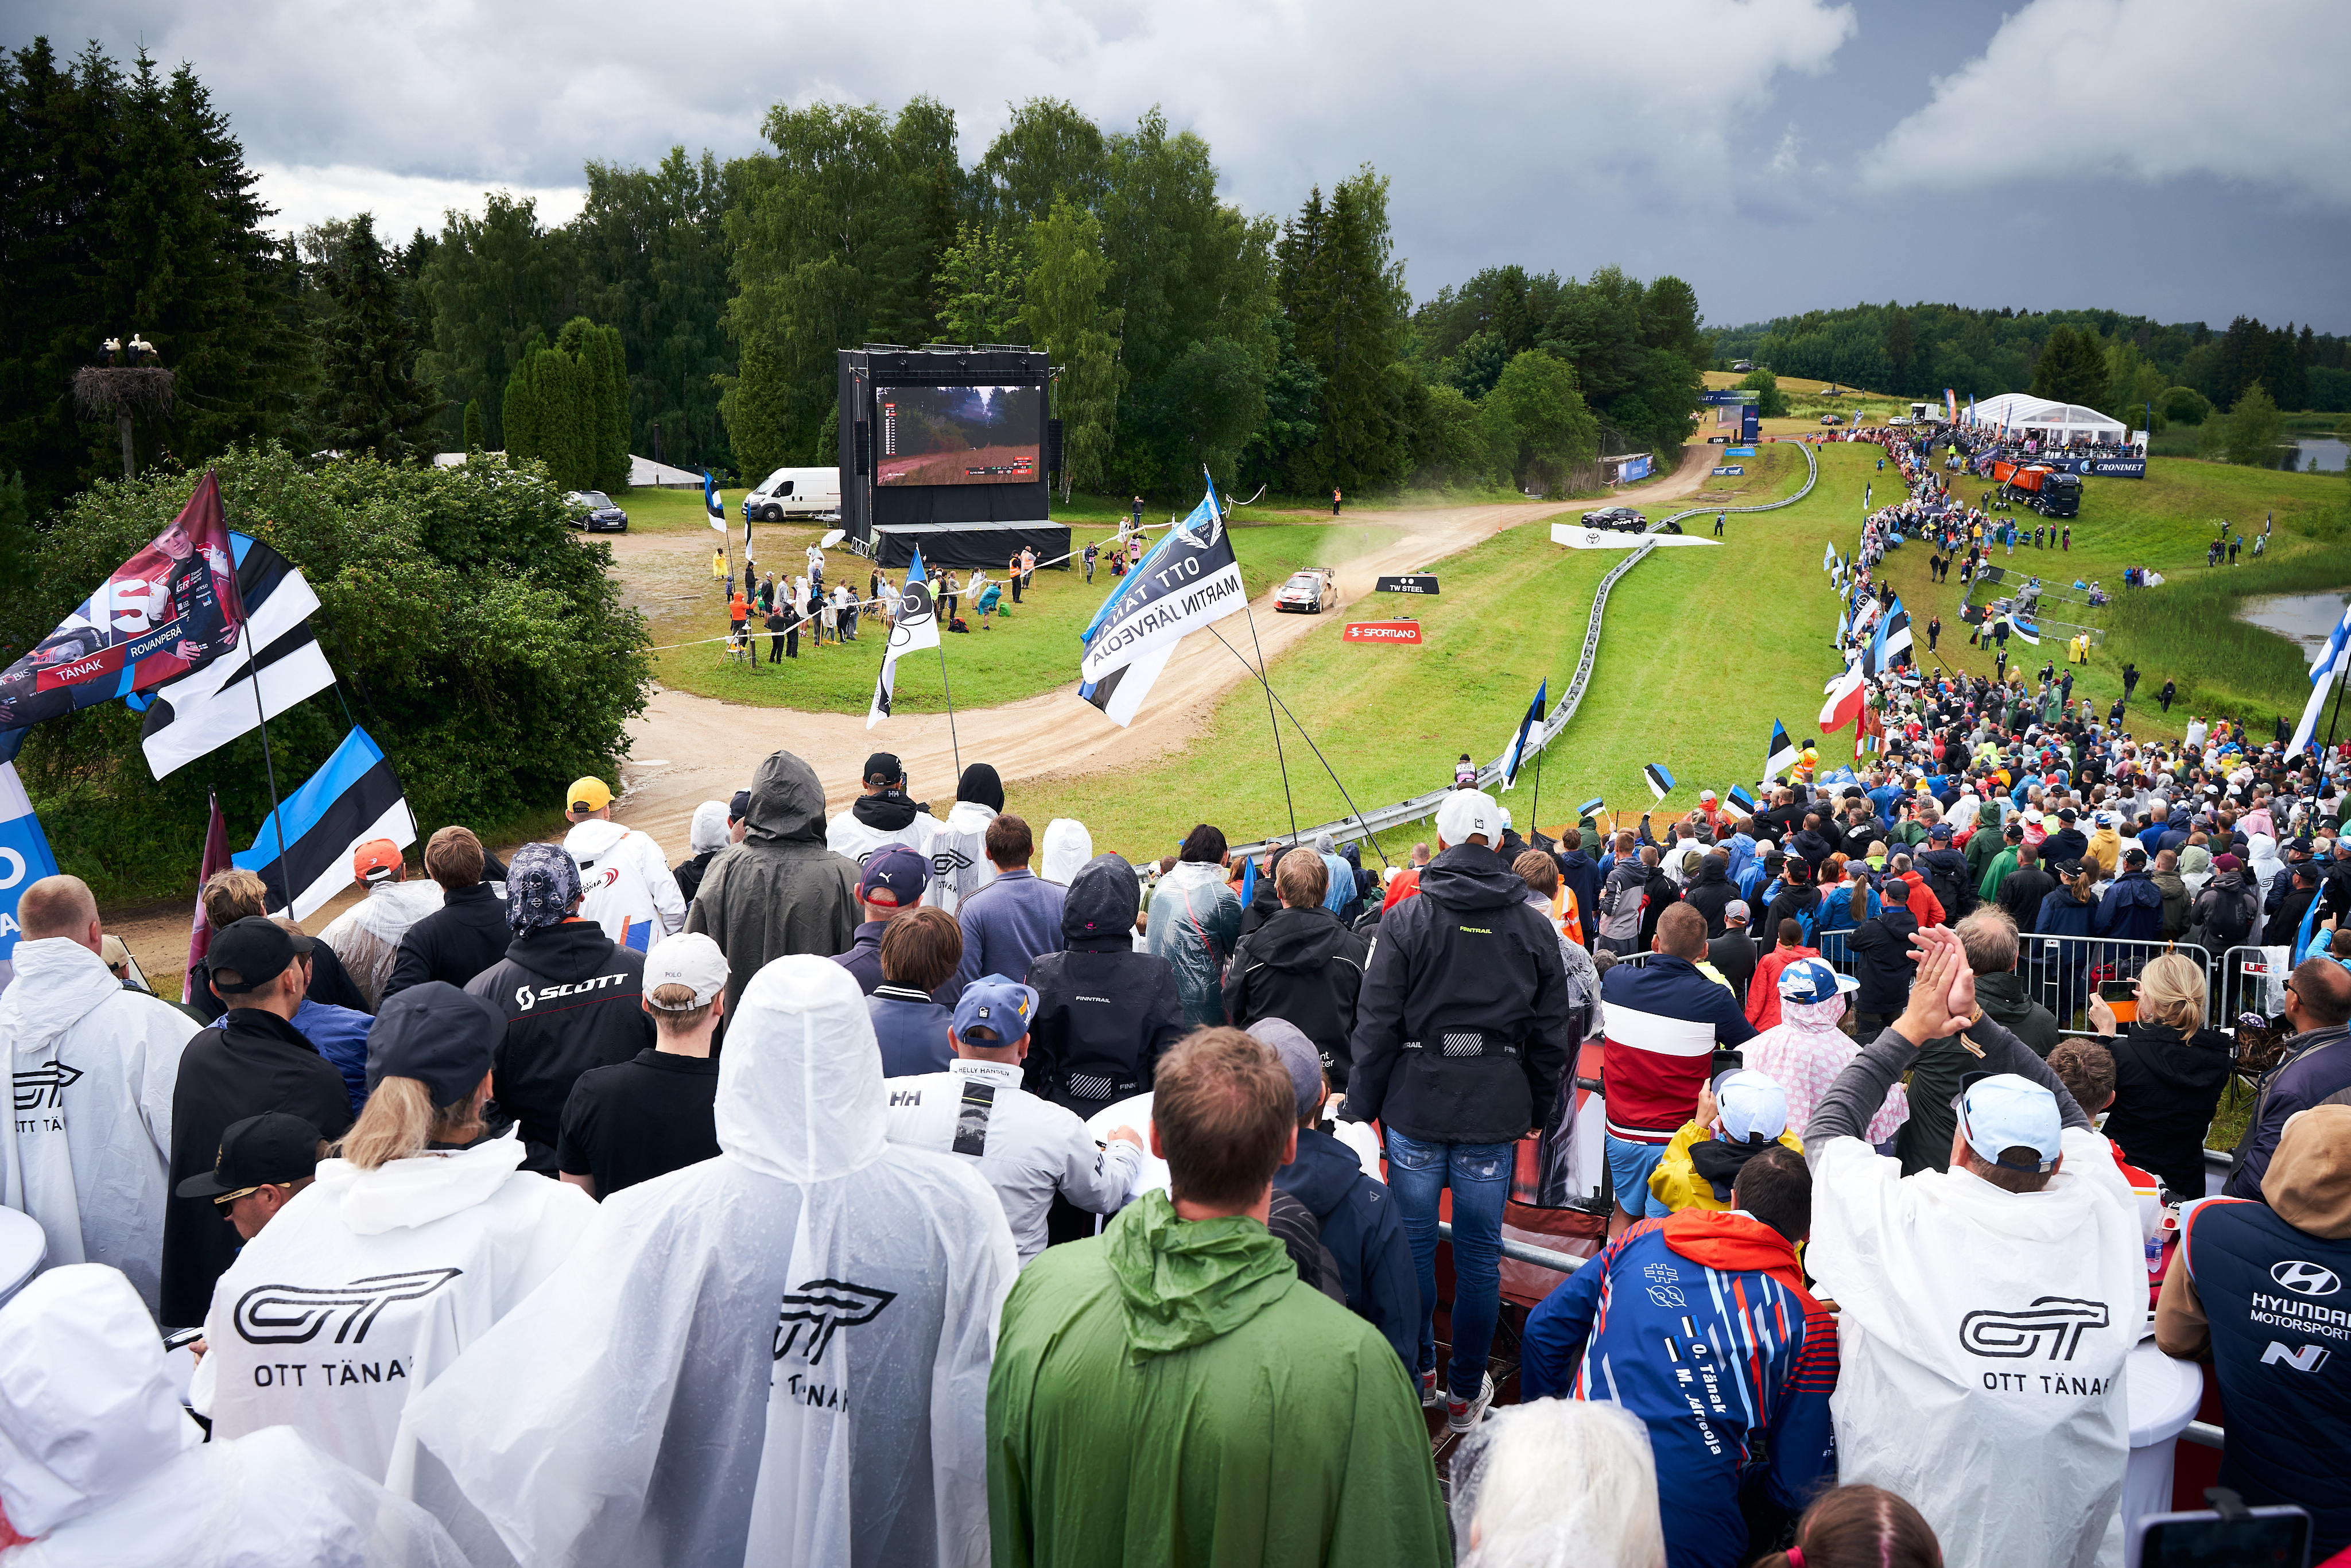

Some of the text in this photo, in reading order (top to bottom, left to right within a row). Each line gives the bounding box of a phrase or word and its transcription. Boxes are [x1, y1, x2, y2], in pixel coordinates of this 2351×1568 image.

[1979, 449, 1999, 460] CRONIMET
[1402, 585, 1424, 593] STEEL
[130, 623, 183, 658] ROVANPERÄ
[1364, 628, 1416, 638] SPORTLAND
[56, 658, 104, 681] TÄNAK
[1460, 926, 1492, 934] FINNTRAIL
[537, 973, 629, 1001] SCOTT
[980, 1068, 1010, 1076] HANSEN
[890, 1090, 921, 1107] HH
[2250, 1309, 2351, 1341] MOTORSPORT
[255, 1357, 413, 1387] OTT TÄNA
[1691, 1344, 1726, 1414] O. Tänak
[1984, 1372, 2026, 1392] OTT
[1675, 1368, 1721, 1456] M. Järveoja
